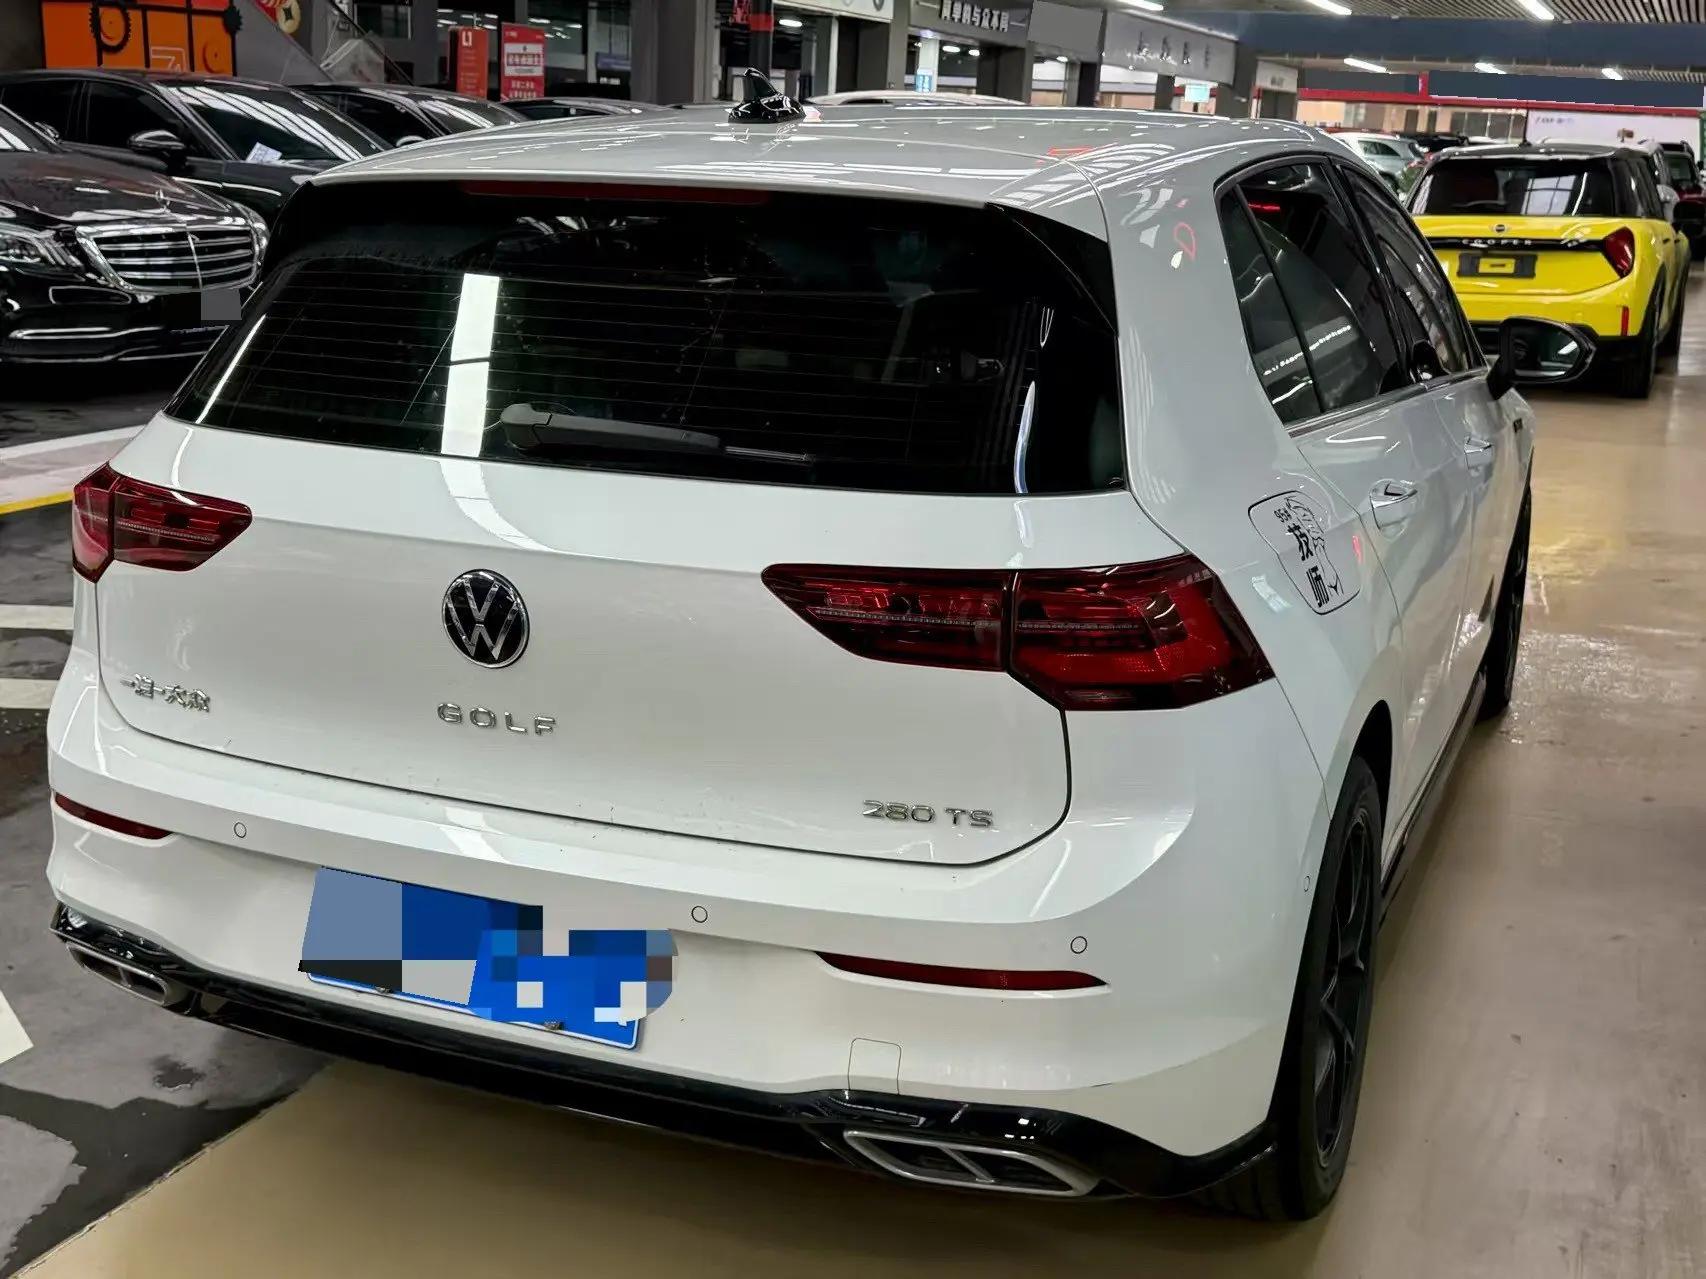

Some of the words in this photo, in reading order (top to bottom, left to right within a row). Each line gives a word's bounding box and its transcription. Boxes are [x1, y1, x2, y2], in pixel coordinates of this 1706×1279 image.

[1462, 238, 1532, 246] COOPER
[436, 702, 557, 736] GOLF
[862, 799, 936, 823] 280
[944, 807, 993, 828] TS
